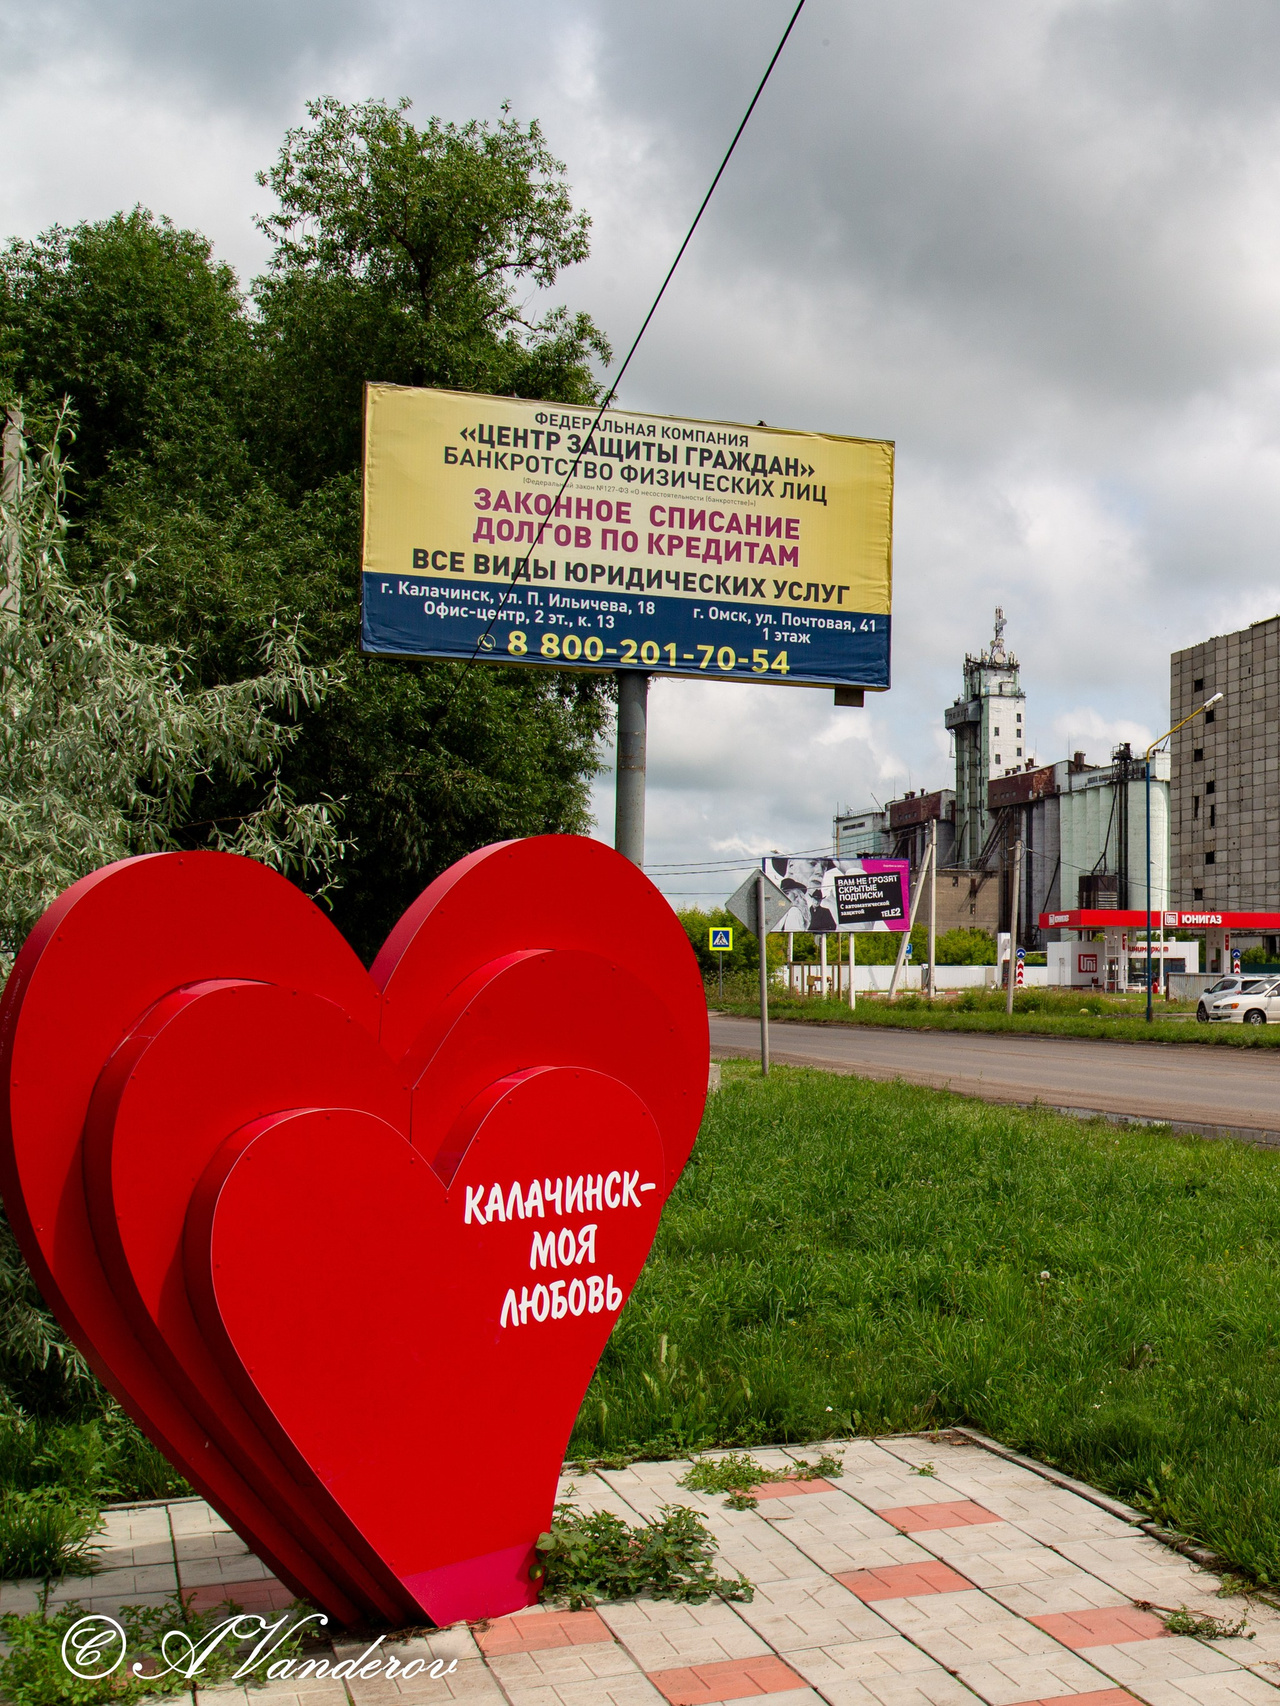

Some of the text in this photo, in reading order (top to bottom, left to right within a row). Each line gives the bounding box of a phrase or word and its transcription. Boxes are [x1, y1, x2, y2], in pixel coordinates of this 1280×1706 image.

[535, 412, 749, 447] ФЕДЕРАЛЬНАЯ КОМПАНИЯ
[460, 423, 816, 478] «ЦЕНТР ЗАЩИТЫ ГРАЖДАН»
[444, 446, 828, 506] БАНКРОТСТВО ФИЗИЧЕСКИХ ЛИЦ
[473, 487, 800, 540] ЗАКОННОЕ СПИСАНИЕ
[472, 516, 799, 568] ДОЛГОВ ПО КРЕДИТАМ
[412, 548, 850, 605] ВСЕ ВИДЫ ЮРИДИЧЕСКИХ УСЛУГ
[381, 581, 656, 616] г. Калачинск, ул. П. Ильичева, 18
[424, 600, 615, 629] Офис-центр, 2 эт., к. 13
[693, 606, 876, 633] г. Омск, ул. Почтовая, 41
[762, 627, 811, 644] 1 этаж
[507, 630, 790, 675] 8 800-201-70-54
[838, 874, 898, 887] ВАМ НЕ ГРОЗЯТ
[838, 884, 878, 894] СКРЫТЫЕ
[839, 891, 884, 902] ПОДПИСКИ
[881, 907, 902, 918] TELE2
[1181, 914, 1222, 925] ЮНИГАЗ
[1080, 955, 1096, 972] Uni
[464, 1169, 656, 1225] КАЛАЧИНСК-
[530, 1224, 598, 1270] МОЯ
[500, 1273, 623, 1328] ЛЮБОВЬ
